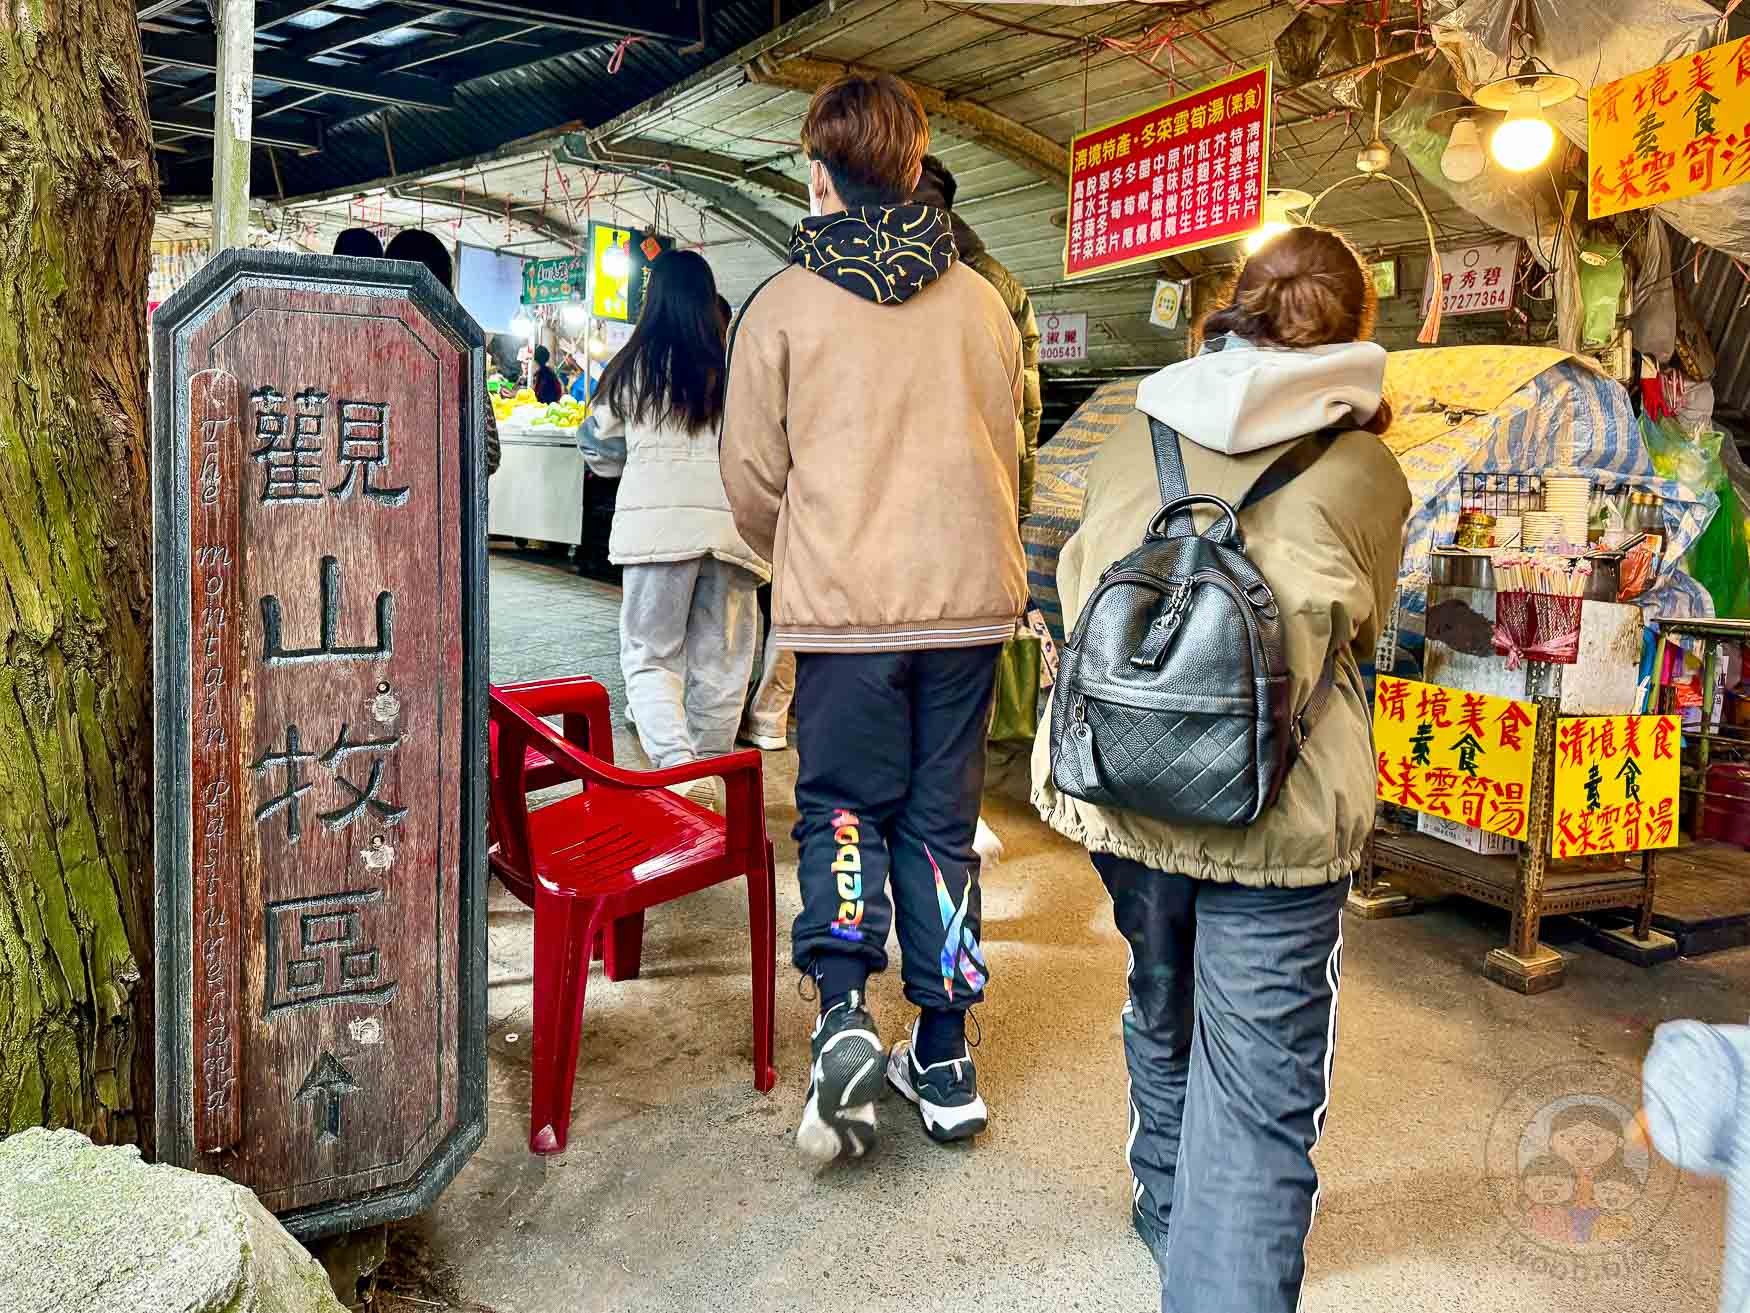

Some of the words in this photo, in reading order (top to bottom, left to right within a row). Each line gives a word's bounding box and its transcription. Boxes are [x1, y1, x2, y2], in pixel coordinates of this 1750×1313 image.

[1632, 90, 1720, 159] 素食
[1179, 145, 1196, 235] 竹炭花生
[1211, 133, 1227, 226] 芥末花生
[1227, 128, 1244, 222] 特濃羊乳片
[1244, 121, 1261, 217] 清境羊乳片
[1427, 289, 1505, 311] 37277364
[200, 416, 231, 505] The
[250, 385, 410, 1021] 觀山牧區
[1378, 680, 1533, 753] 清境美食
[1409, 720, 1485, 777] 素食
[1560, 714, 1677, 769] 清境美食
[1584, 756, 1642, 811] 素食
[1555, 798, 1673, 860] 冬菜雲筍湯
